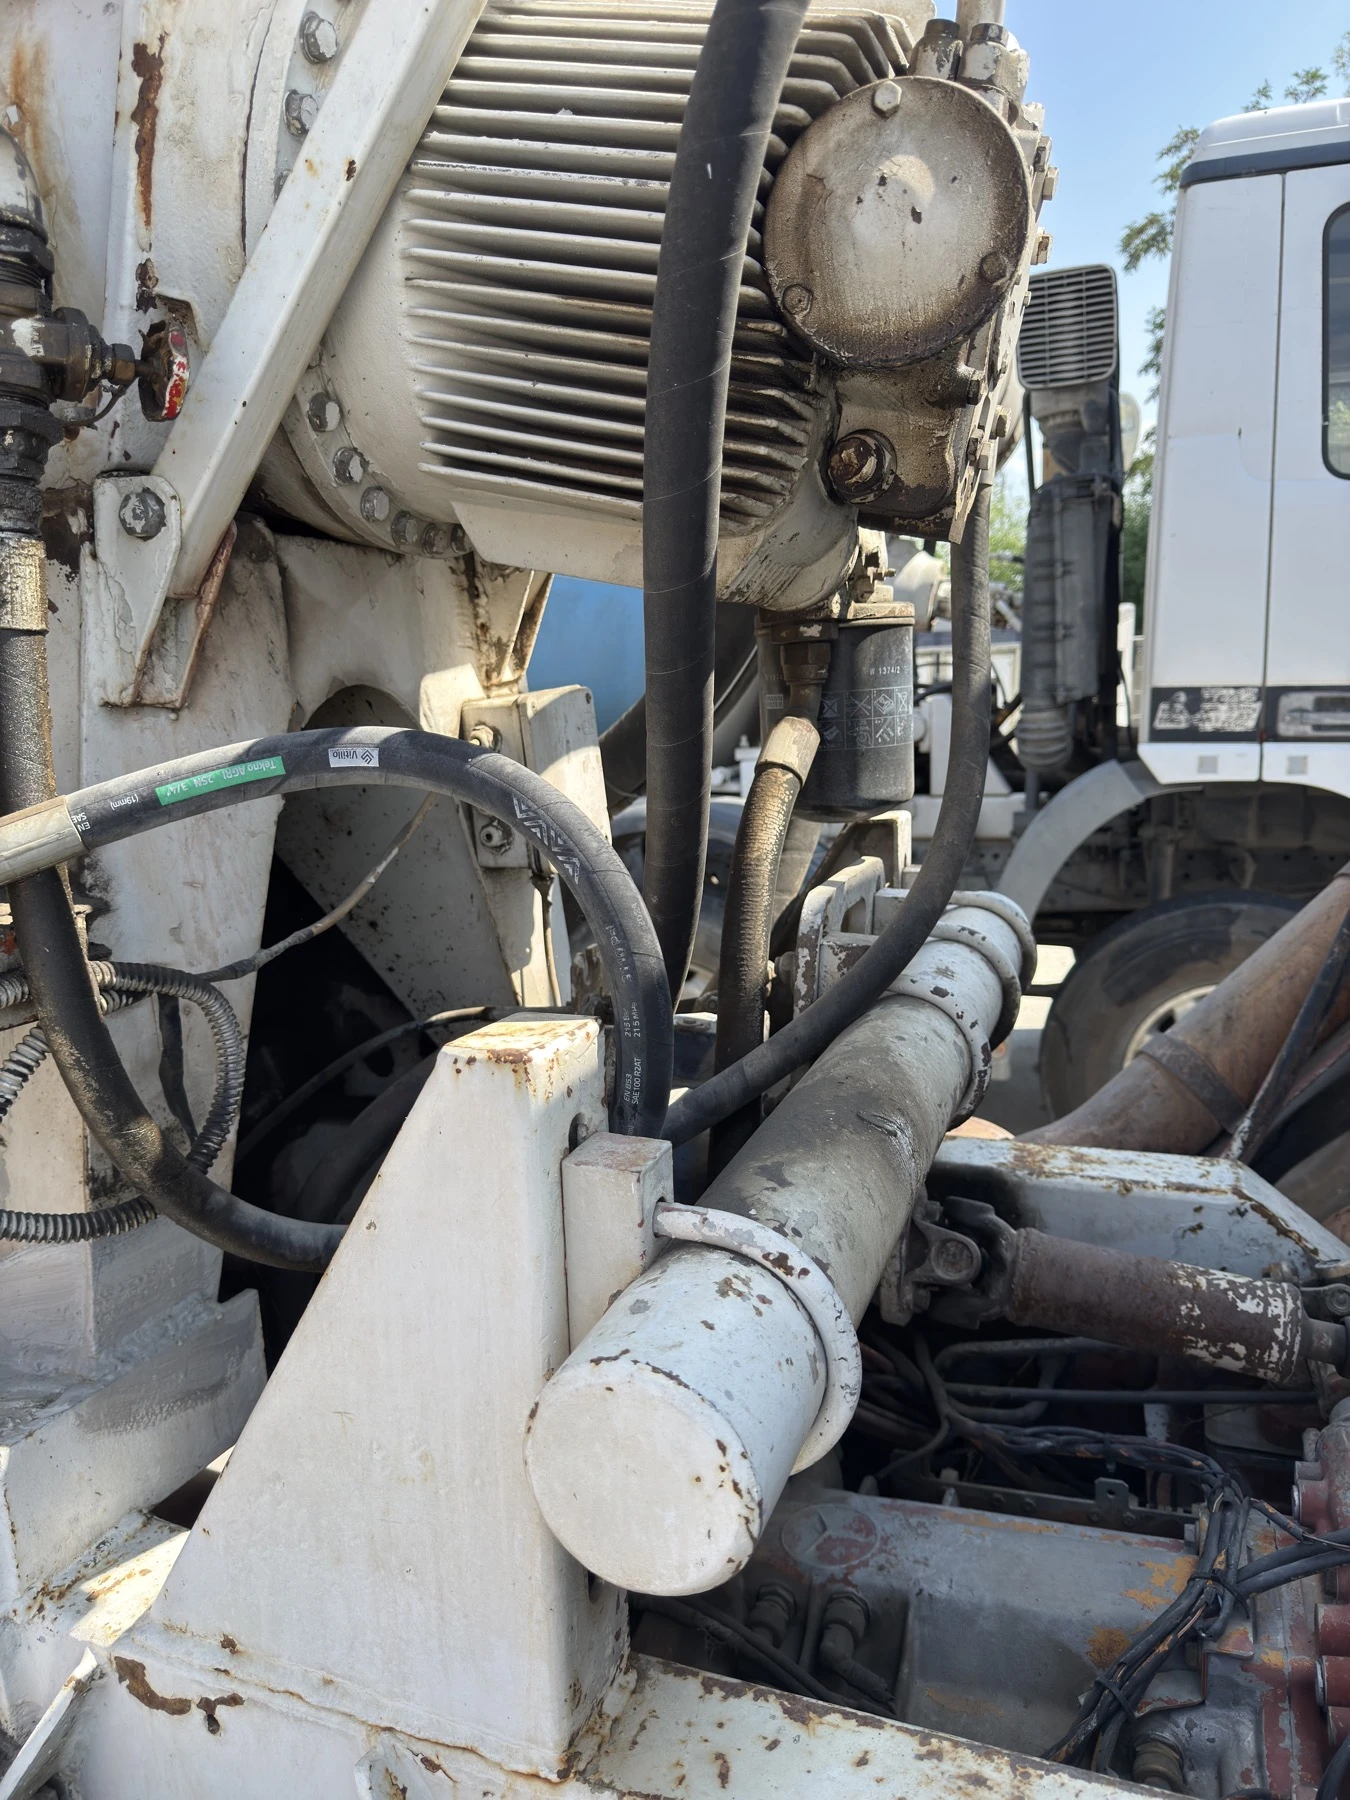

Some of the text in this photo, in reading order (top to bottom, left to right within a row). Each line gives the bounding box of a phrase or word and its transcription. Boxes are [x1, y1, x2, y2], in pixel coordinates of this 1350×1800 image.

[332, 750, 358, 760] Vitillo
[247, 759, 276, 771] Tekno
[222, 766, 245, 780] AGRI
[193, 774, 214, 787] 2SN
[109, 793, 139, 810] (19mm)
[71, 812, 87, 824] SAE
[77, 821, 91, 832] EN
[624, 1021, 632, 1038] 215
[633, 1057, 642, 1077] R2AT
[623, 1073, 633, 1102] EN 853
